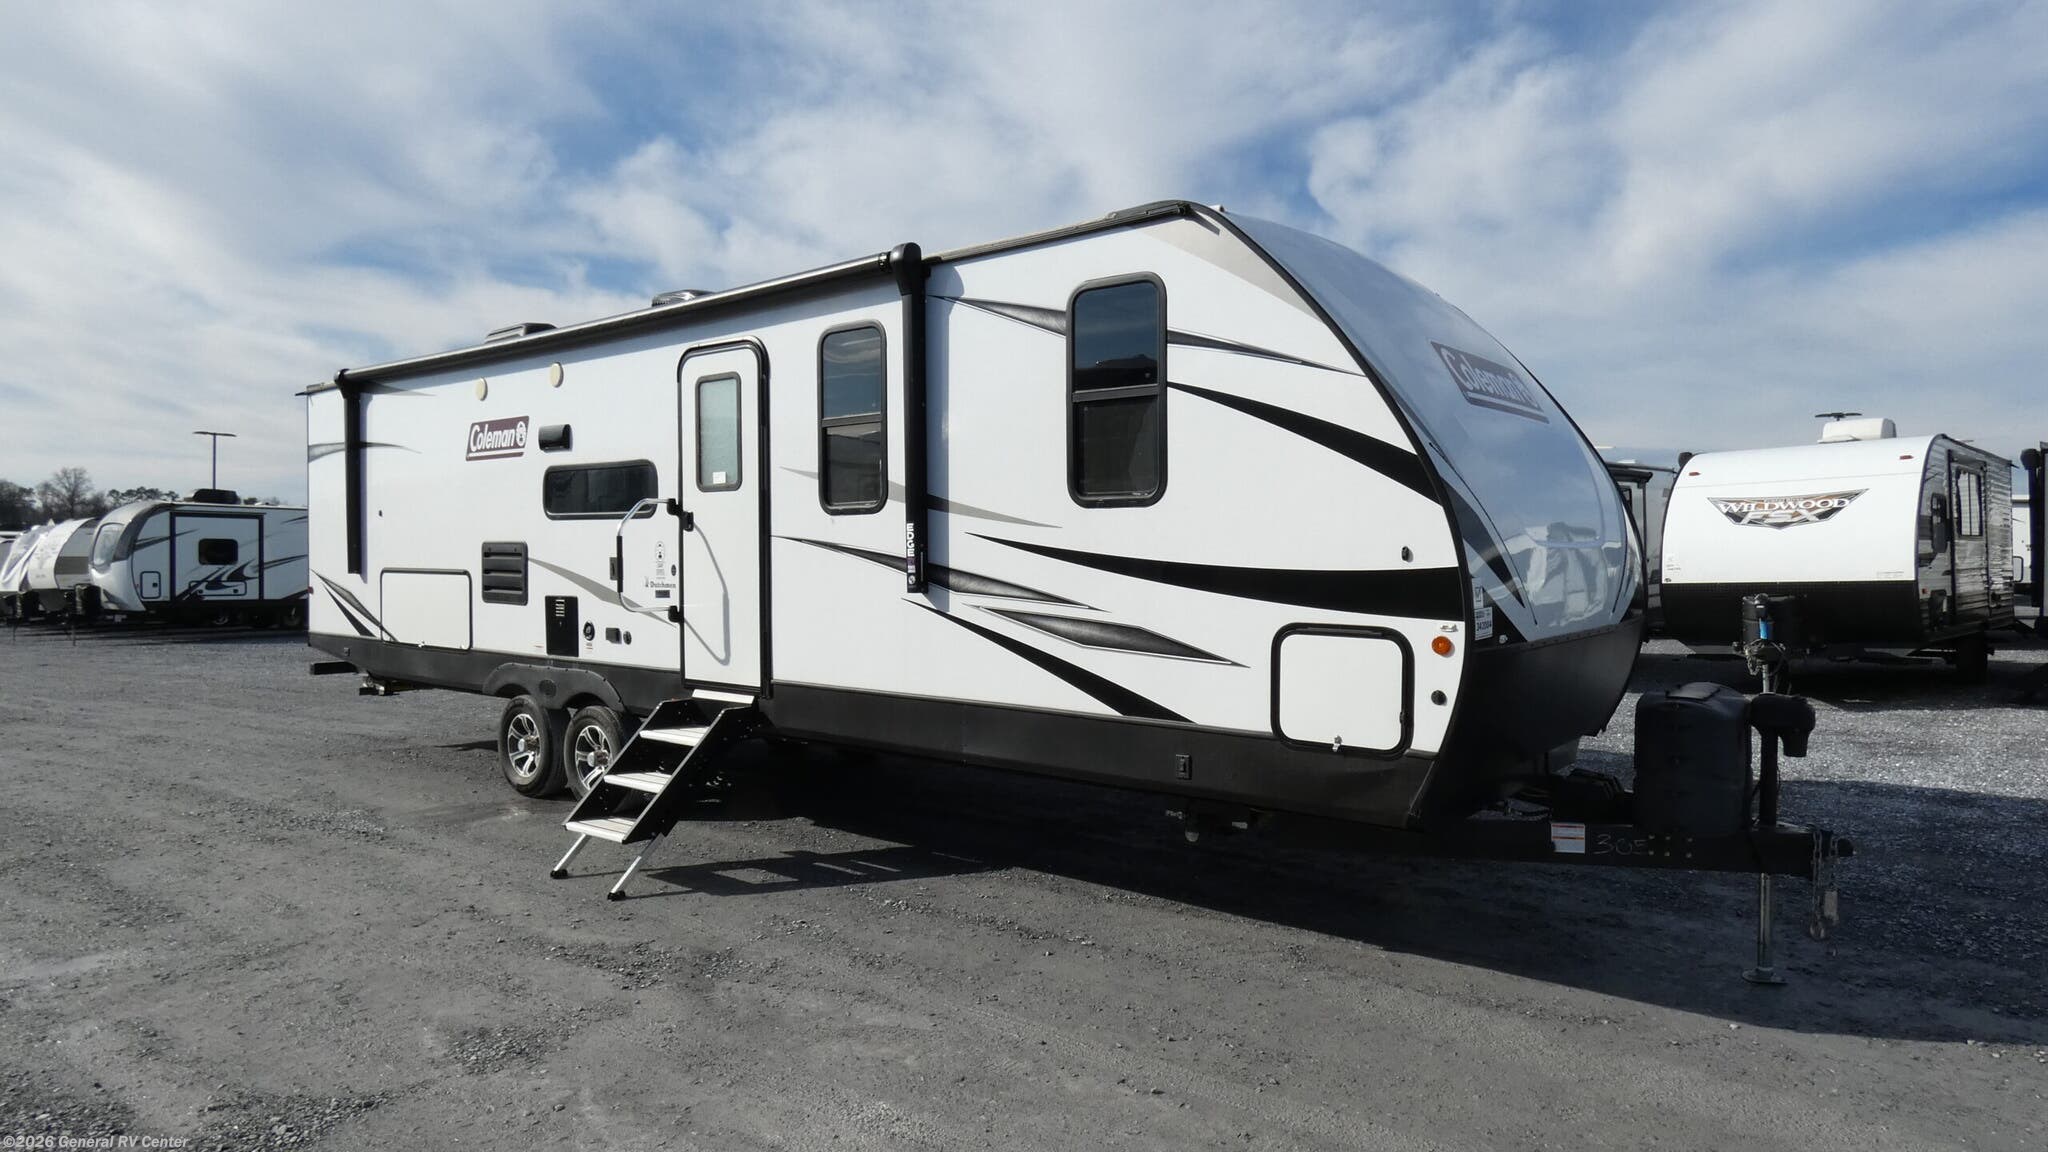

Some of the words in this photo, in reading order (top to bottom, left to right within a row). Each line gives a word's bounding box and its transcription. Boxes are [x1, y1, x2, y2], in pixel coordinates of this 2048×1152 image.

[1440, 347, 1527, 403] Coleman
[470, 423, 516, 452] Coleman
[1717, 498, 1850, 512] WILDWOOD
[906, 522, 915, 557] EDGE
